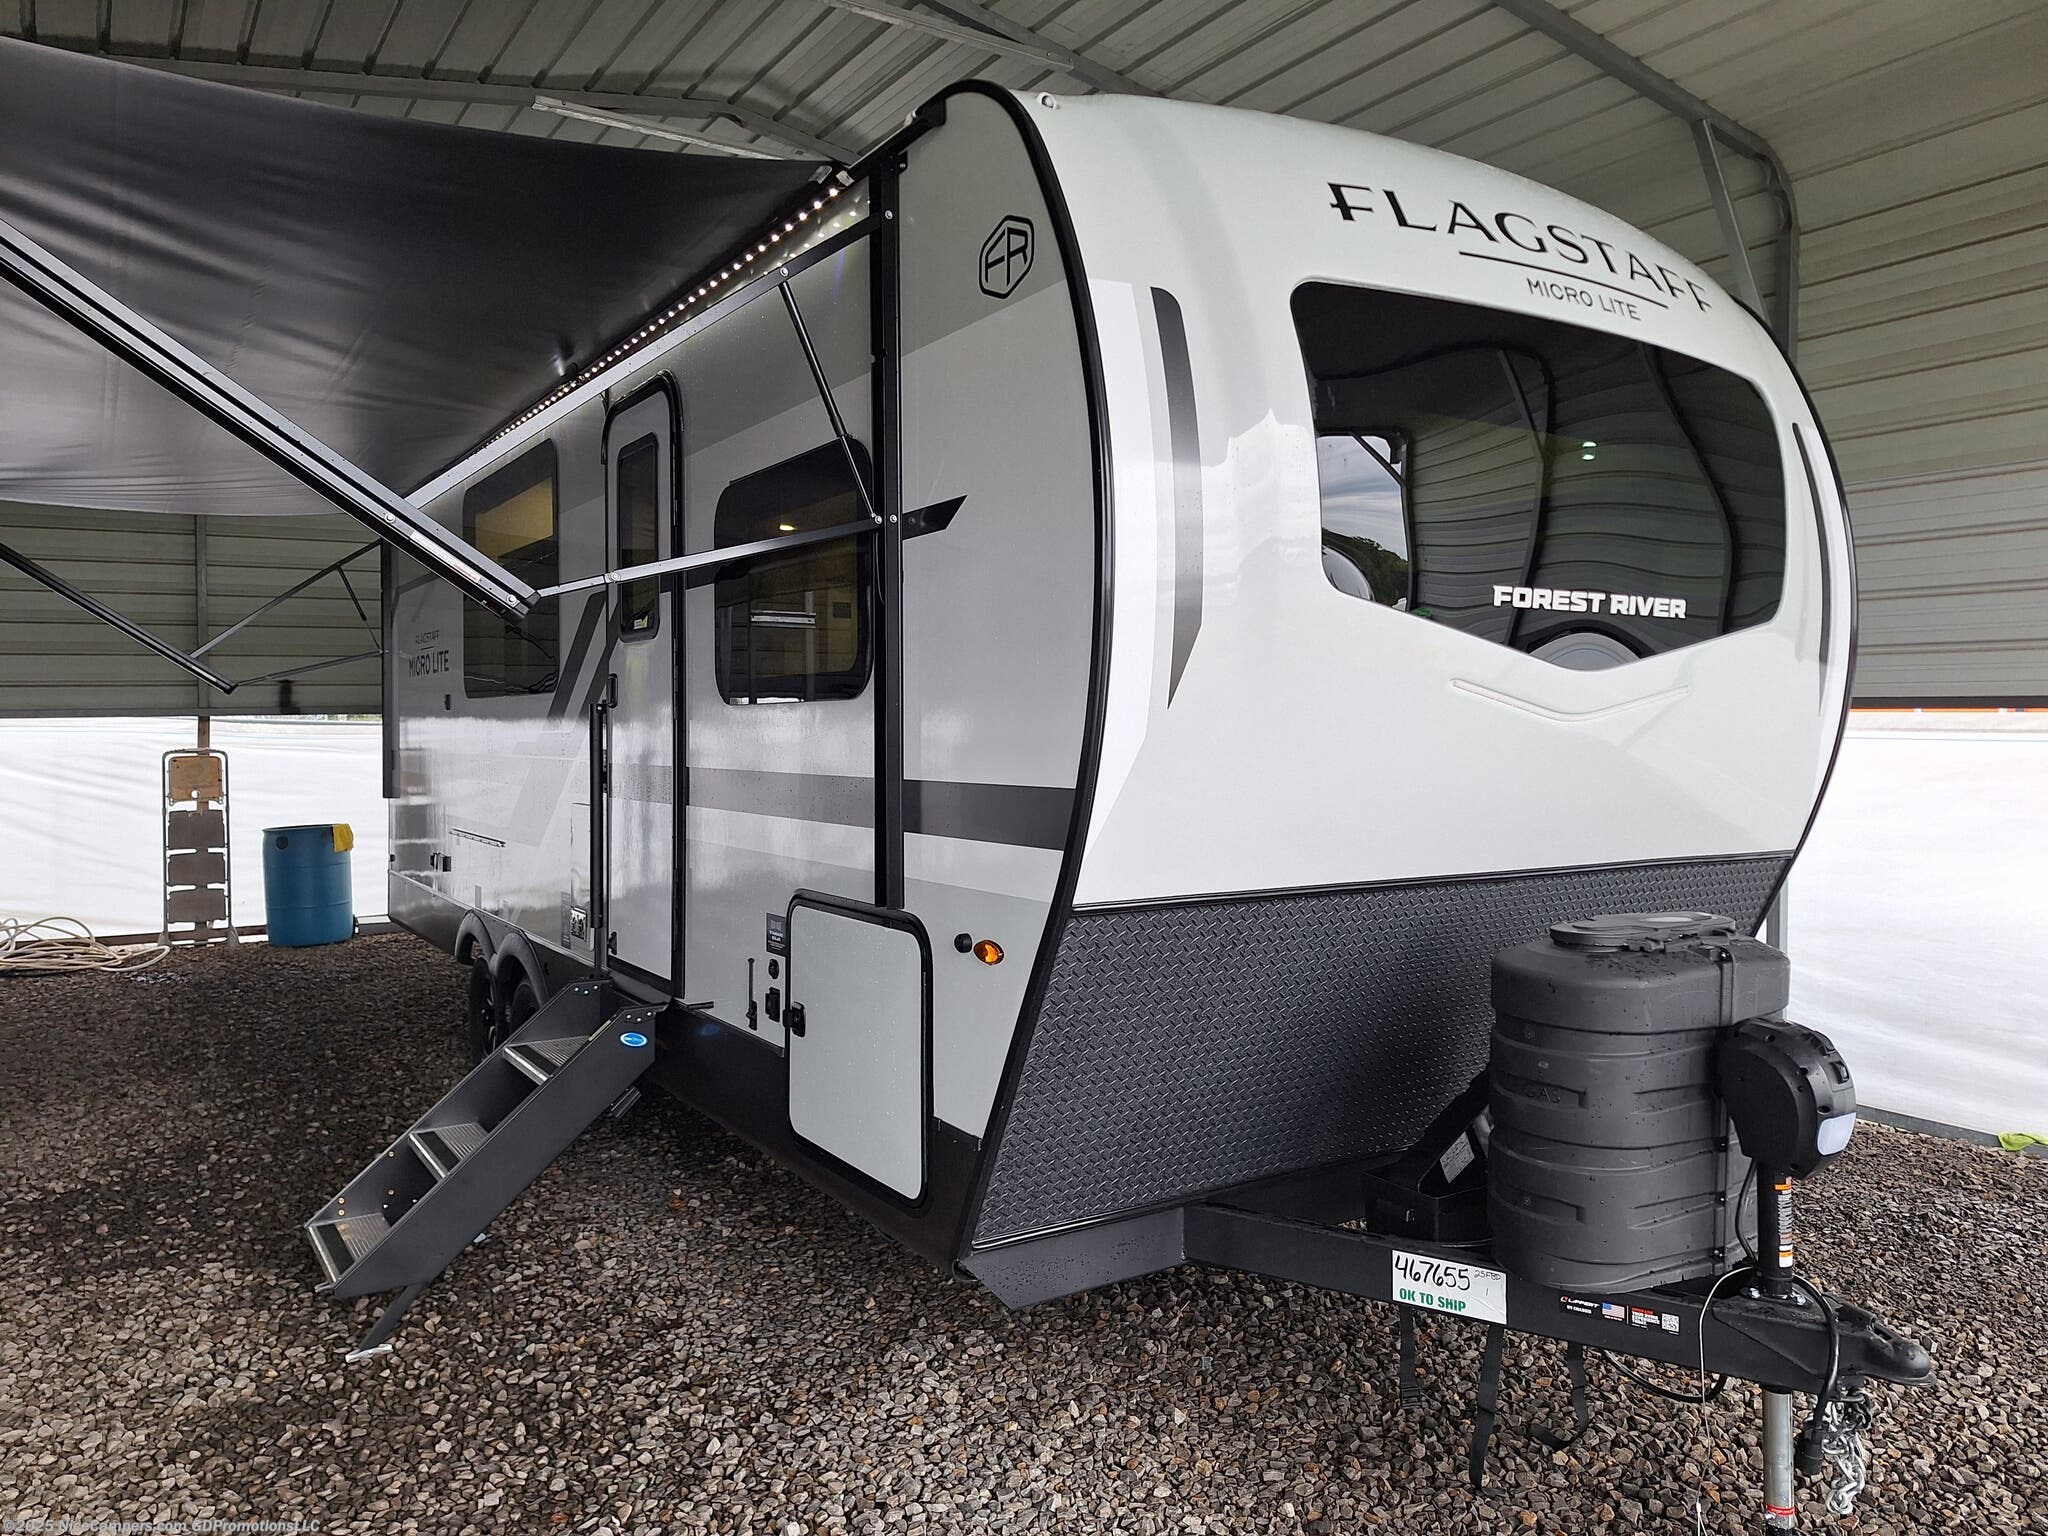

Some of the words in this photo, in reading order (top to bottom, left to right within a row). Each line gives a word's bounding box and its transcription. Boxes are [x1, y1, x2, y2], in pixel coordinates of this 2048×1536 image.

[1327, 182, 1713, 313] FLAGSTAFF
[1526, 276, 1593, 308] MICRO
[1598, 293, 1642, 321] LITE
[1493, 585, 1606, 614] FOREST
[1609, 593, 1687, 619] RIVER
[408, 653, 431, 678] MICRO
[433, 649, 450, 674] LITE
[1394, 1254, 1471, 1291] 467655
[1399, 1287, 1416, 1302] OK
[1419, 1292, 1434, 1306] TO
[1437, 1296, 1467, 1312] SHIP
